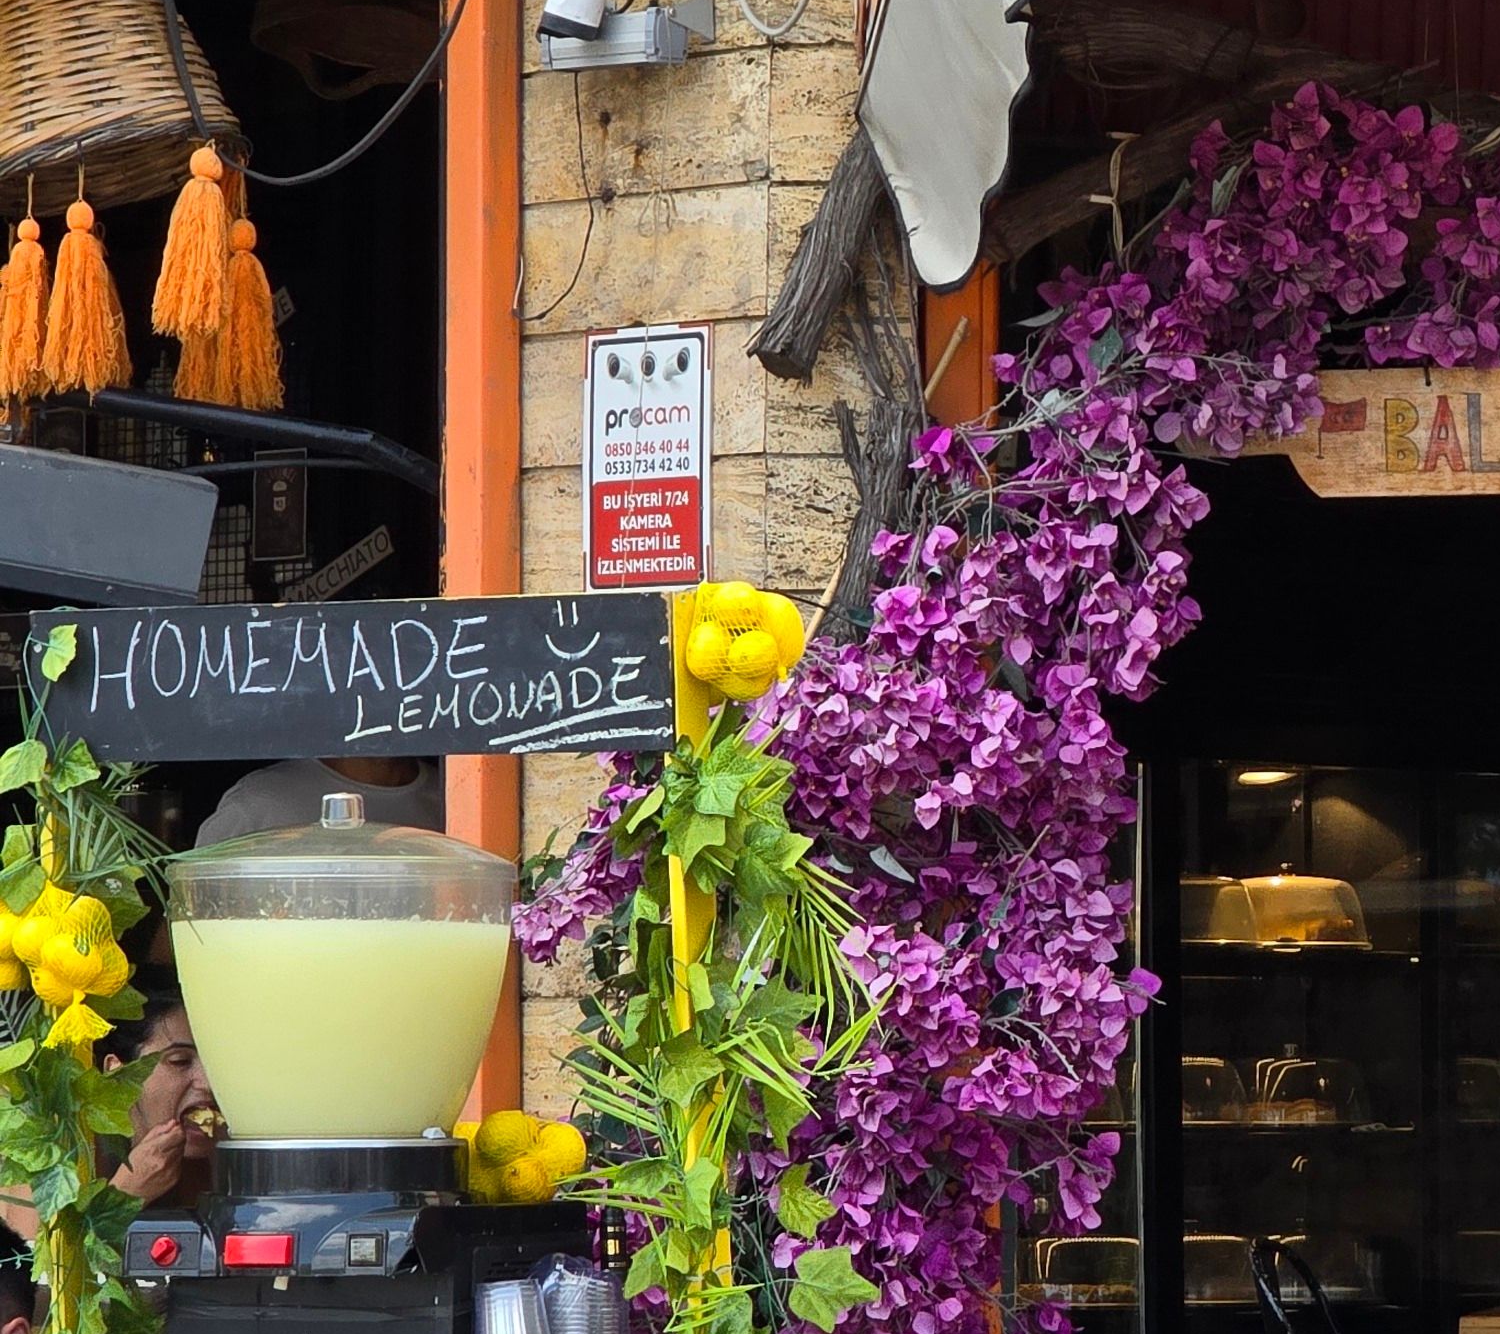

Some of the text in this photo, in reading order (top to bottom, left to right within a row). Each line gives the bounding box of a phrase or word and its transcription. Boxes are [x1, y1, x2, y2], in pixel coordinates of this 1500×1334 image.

[605, 404, 690, 436] procam
[605, 438, 690, 457] 0850 346 40 44
[605, 456, 690, 475] 0533 734 42 40
[603, 488, 689, 511] BU İŞYERİ 7/24
[620, 513, 672, 530] KAMERA
[611, 532, 681, 552] SİSTEMİ İLE
[597, 552, 695, 575] İZLENMEKTEDİR
[89, 616, 489, 712] HOMEMADE
[345, 656, 647, 742] LEMONADE
